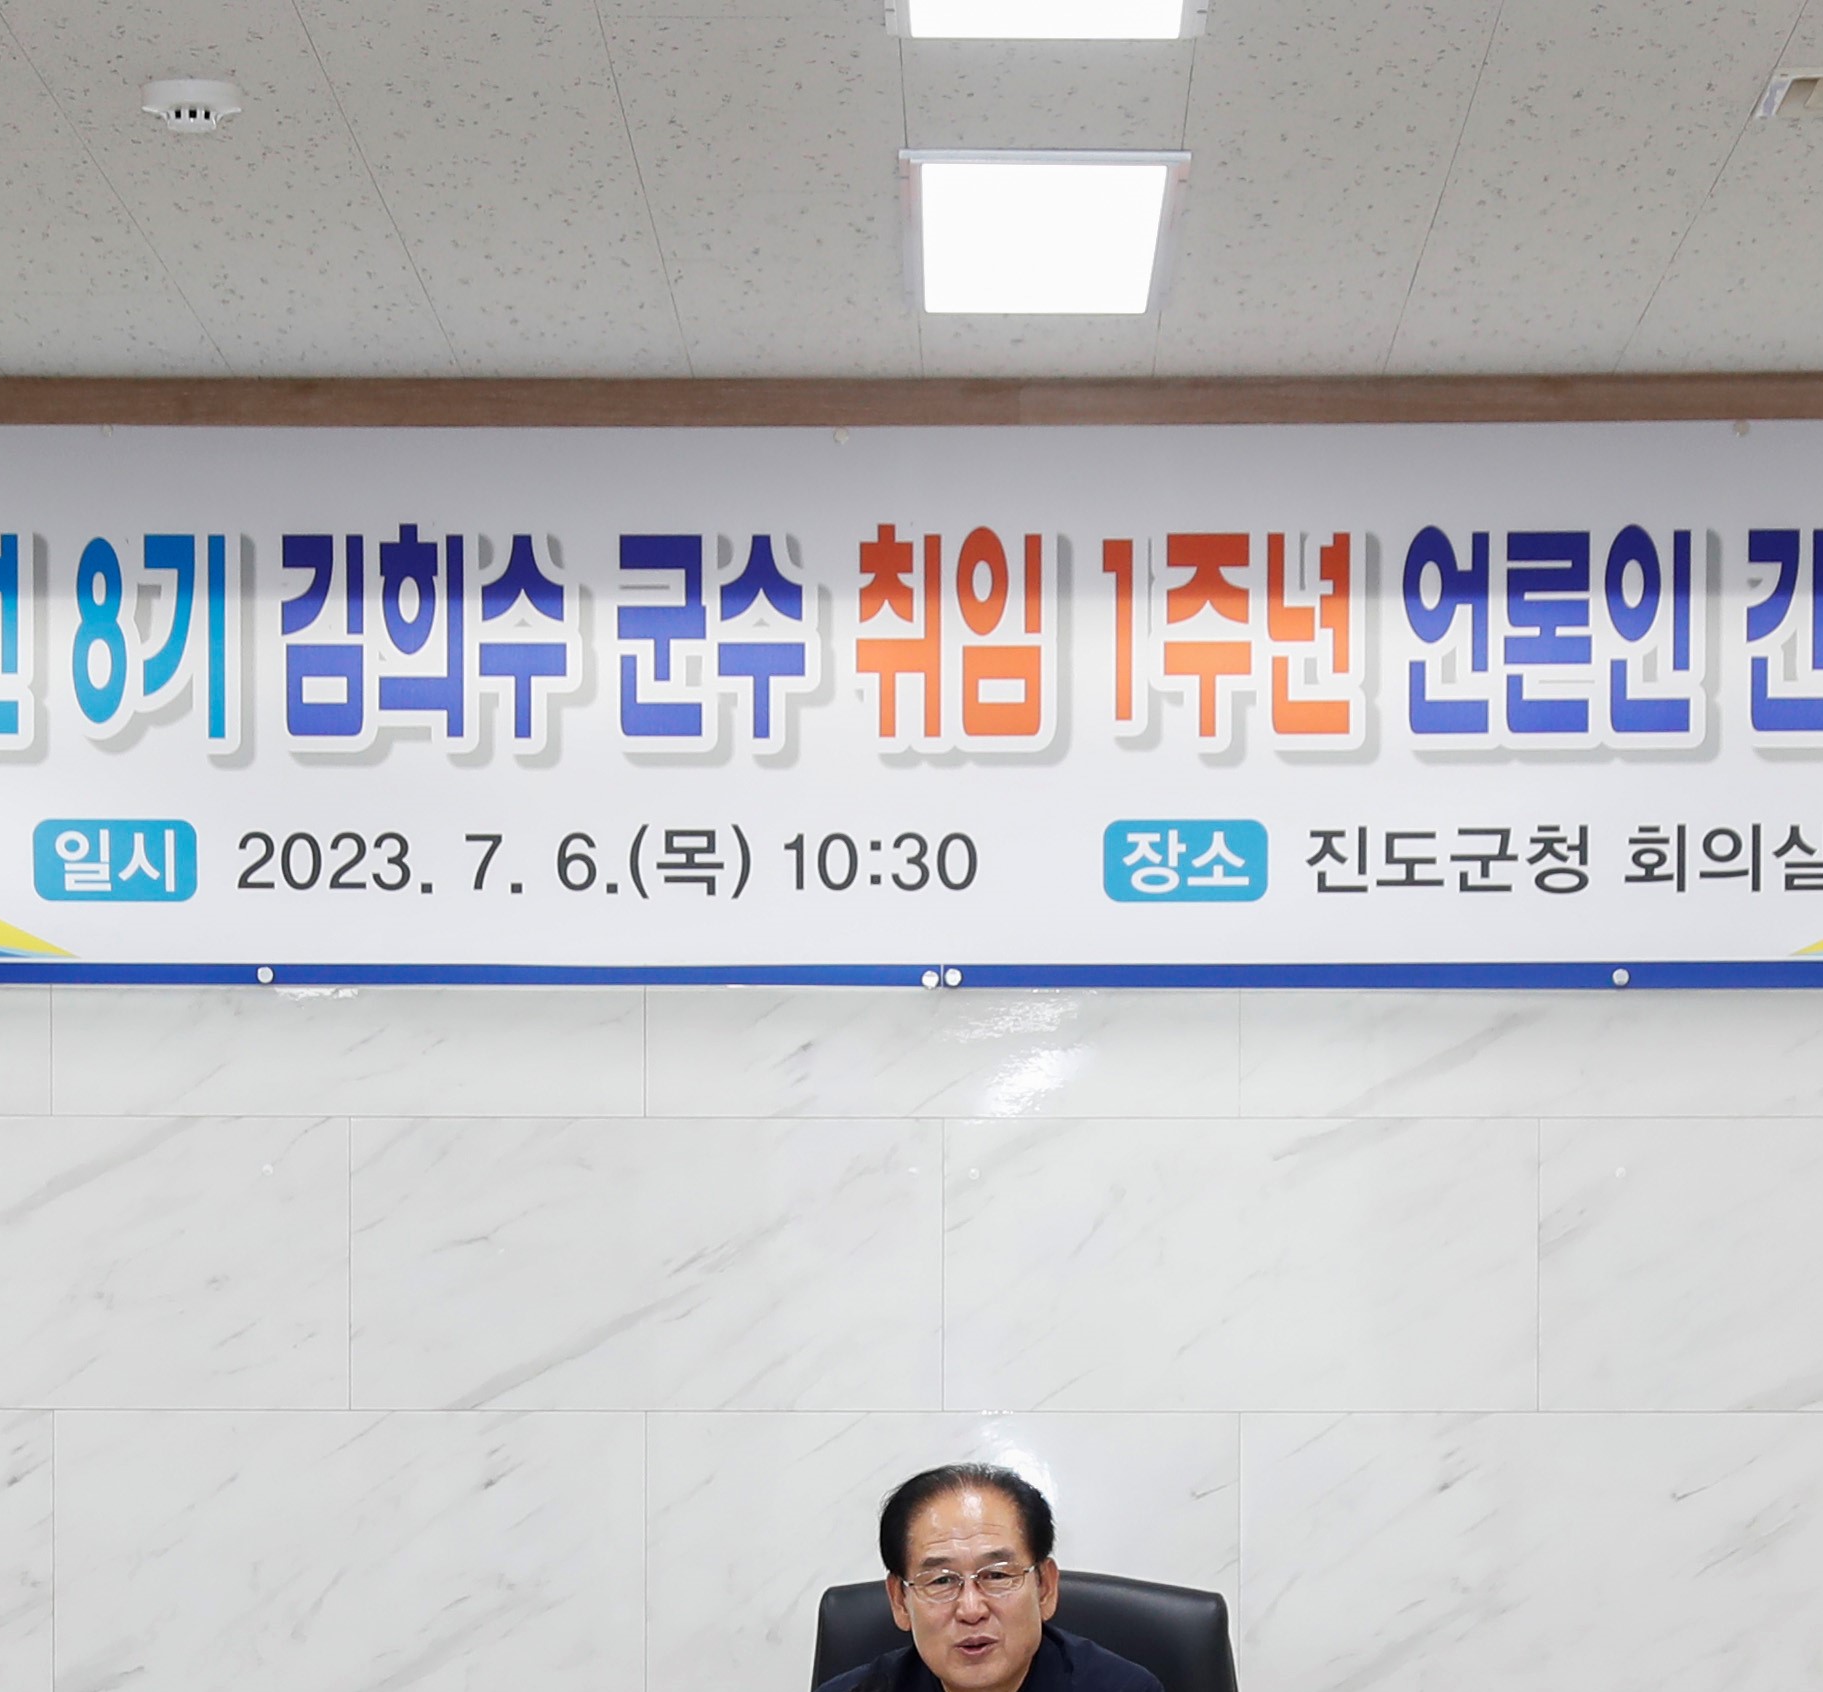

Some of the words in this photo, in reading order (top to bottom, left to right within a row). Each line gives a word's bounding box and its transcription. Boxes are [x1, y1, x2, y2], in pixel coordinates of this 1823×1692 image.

[72, 533, 227, 739] 8기
[279, 524, 567, 739] 김희수
[618, 534, 807, 739] 군수
[856, 524, 1043, 738] 취임
[1102, 530, 1351, 737] 1주년
[1402, 525, 1692, 733] 언론인
[54, 829, 175, 892] 일시
[237, 831, 434, 894] 2023.
[465, 833, 524, 894] 7.
[557, 824, 751, 900] 6.(목)
[785, 832, 978, 892] 10:30
[1123, 829, 1249, 893] 장소
[1306, 824, 1590, 894] 진도군청
